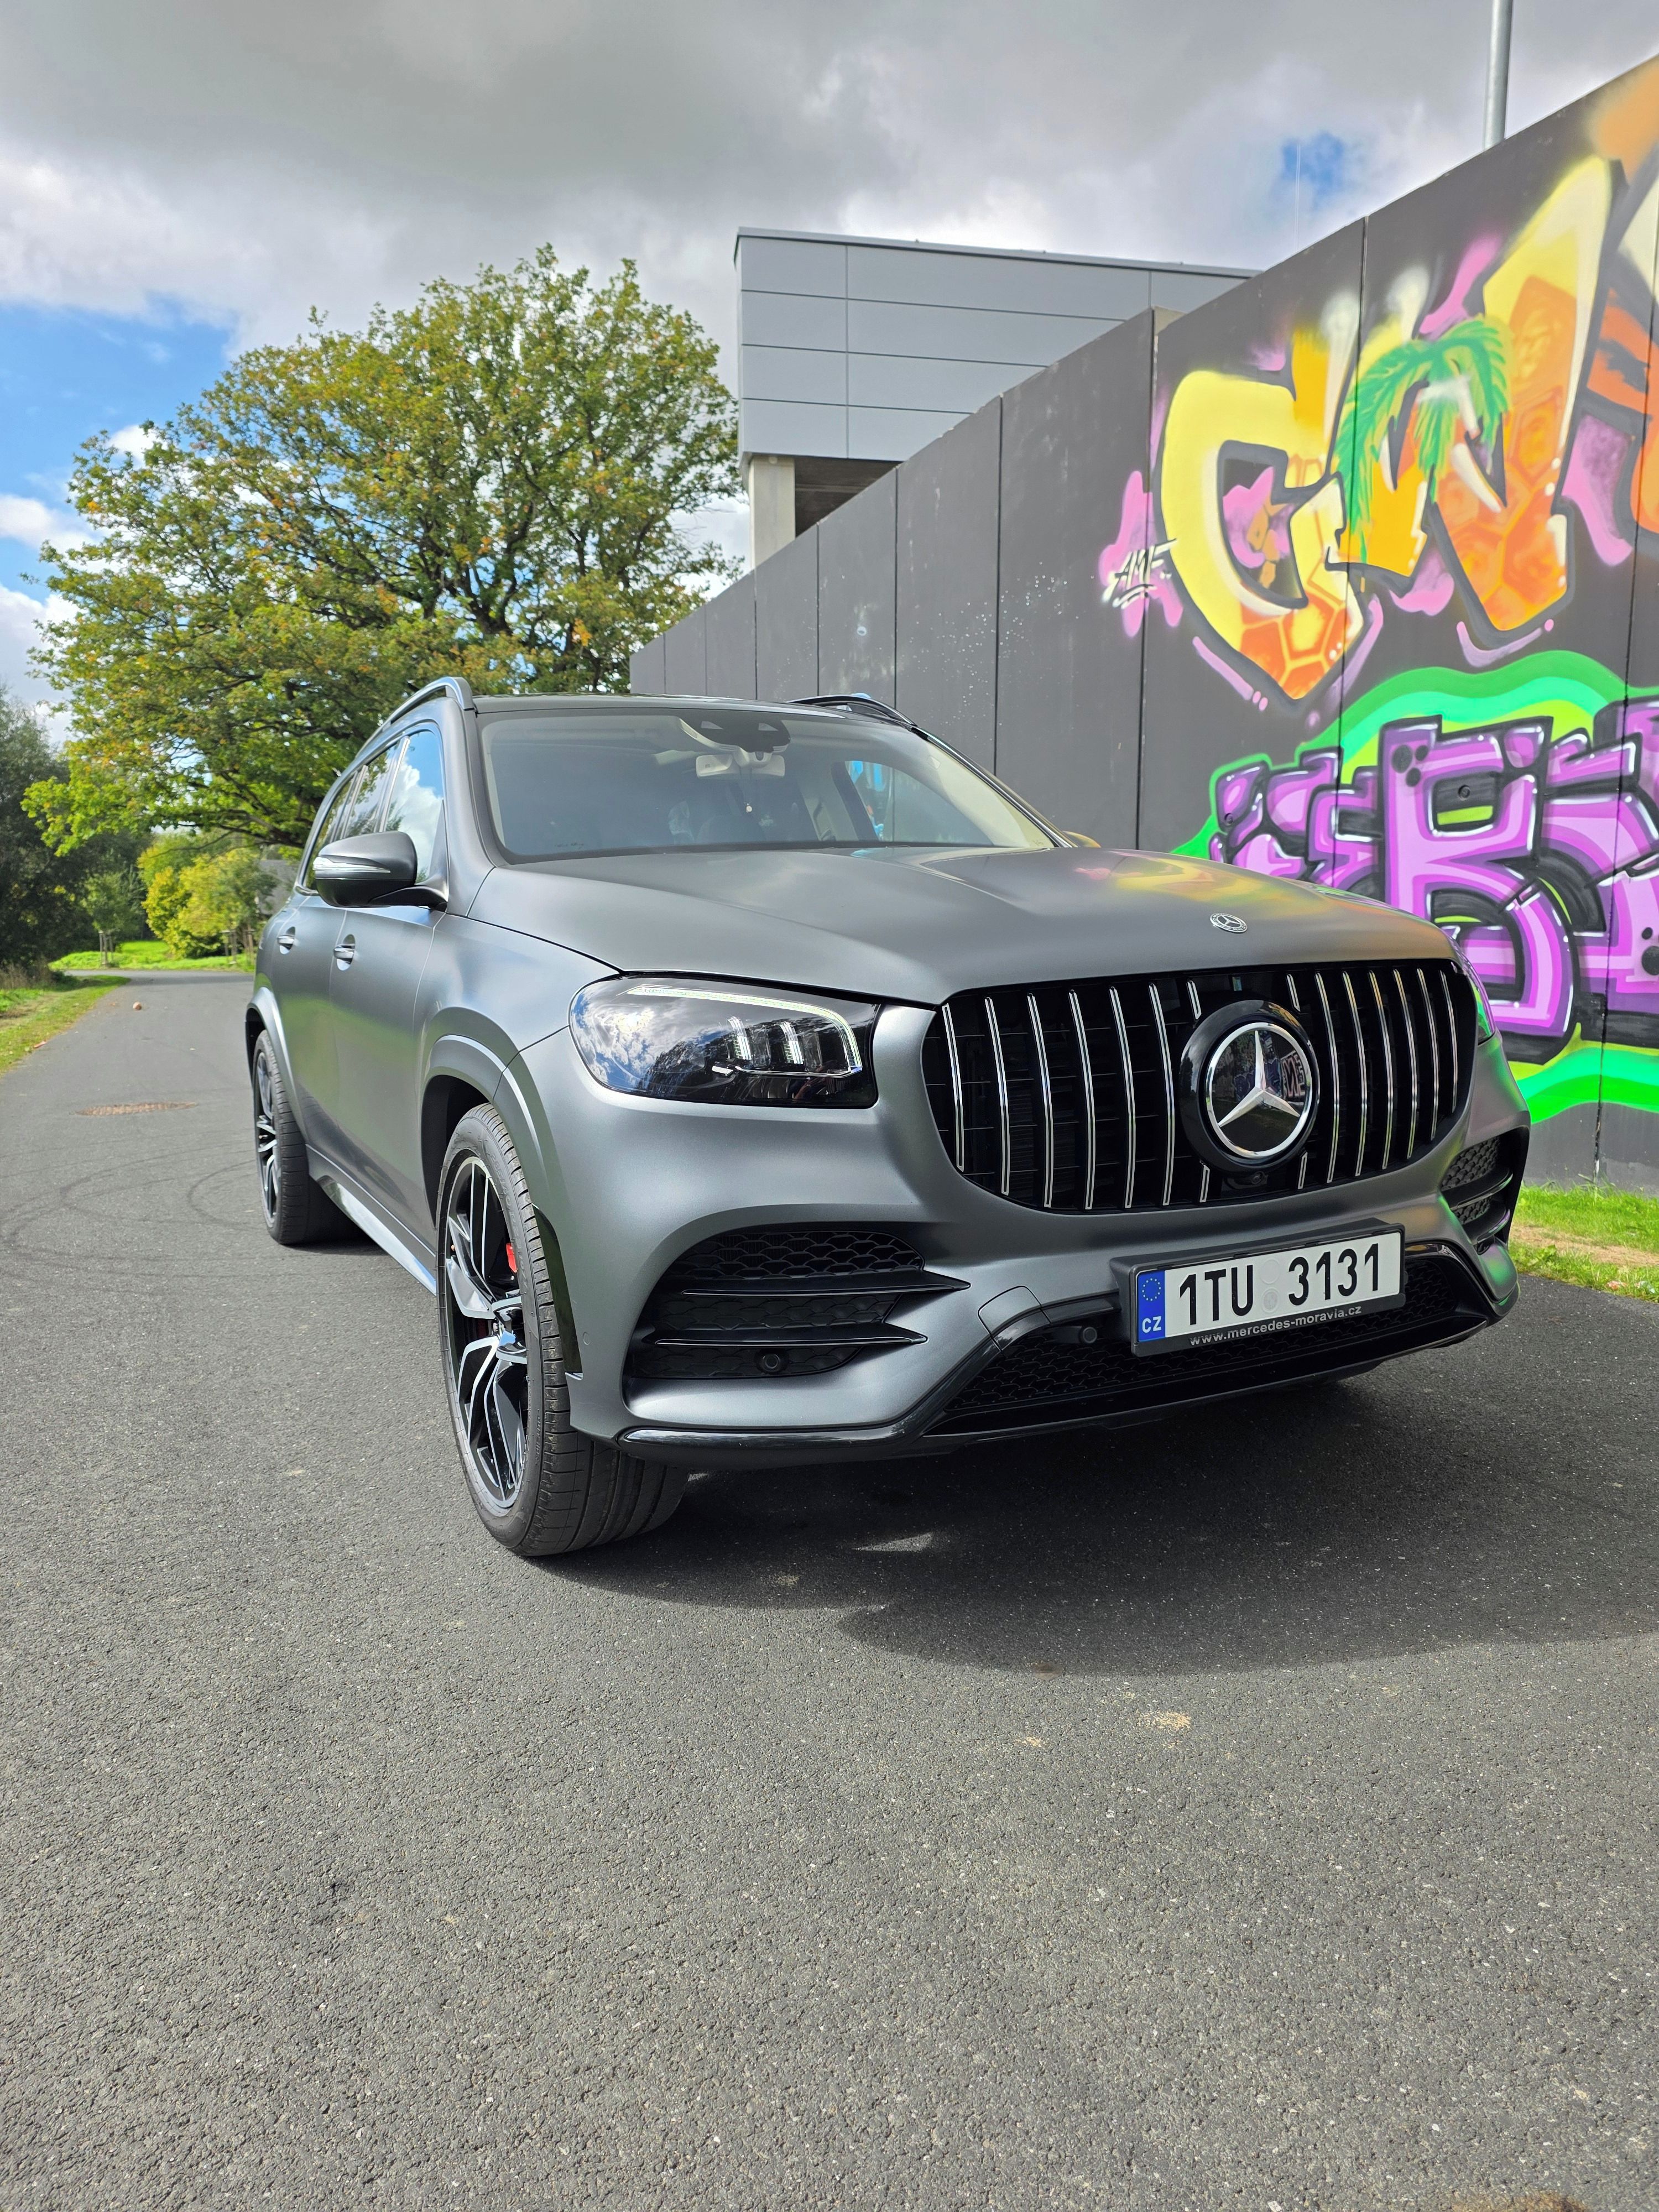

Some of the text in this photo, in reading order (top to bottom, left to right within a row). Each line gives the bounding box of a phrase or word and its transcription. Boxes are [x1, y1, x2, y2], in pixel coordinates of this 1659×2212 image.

[1179, 1243, 1379, 1326] 1TU 3131
[1142, 1316, 1162, 1333] CZ
[1190, 1305, 1361, 1346] www.mercedes-moravia.cz
